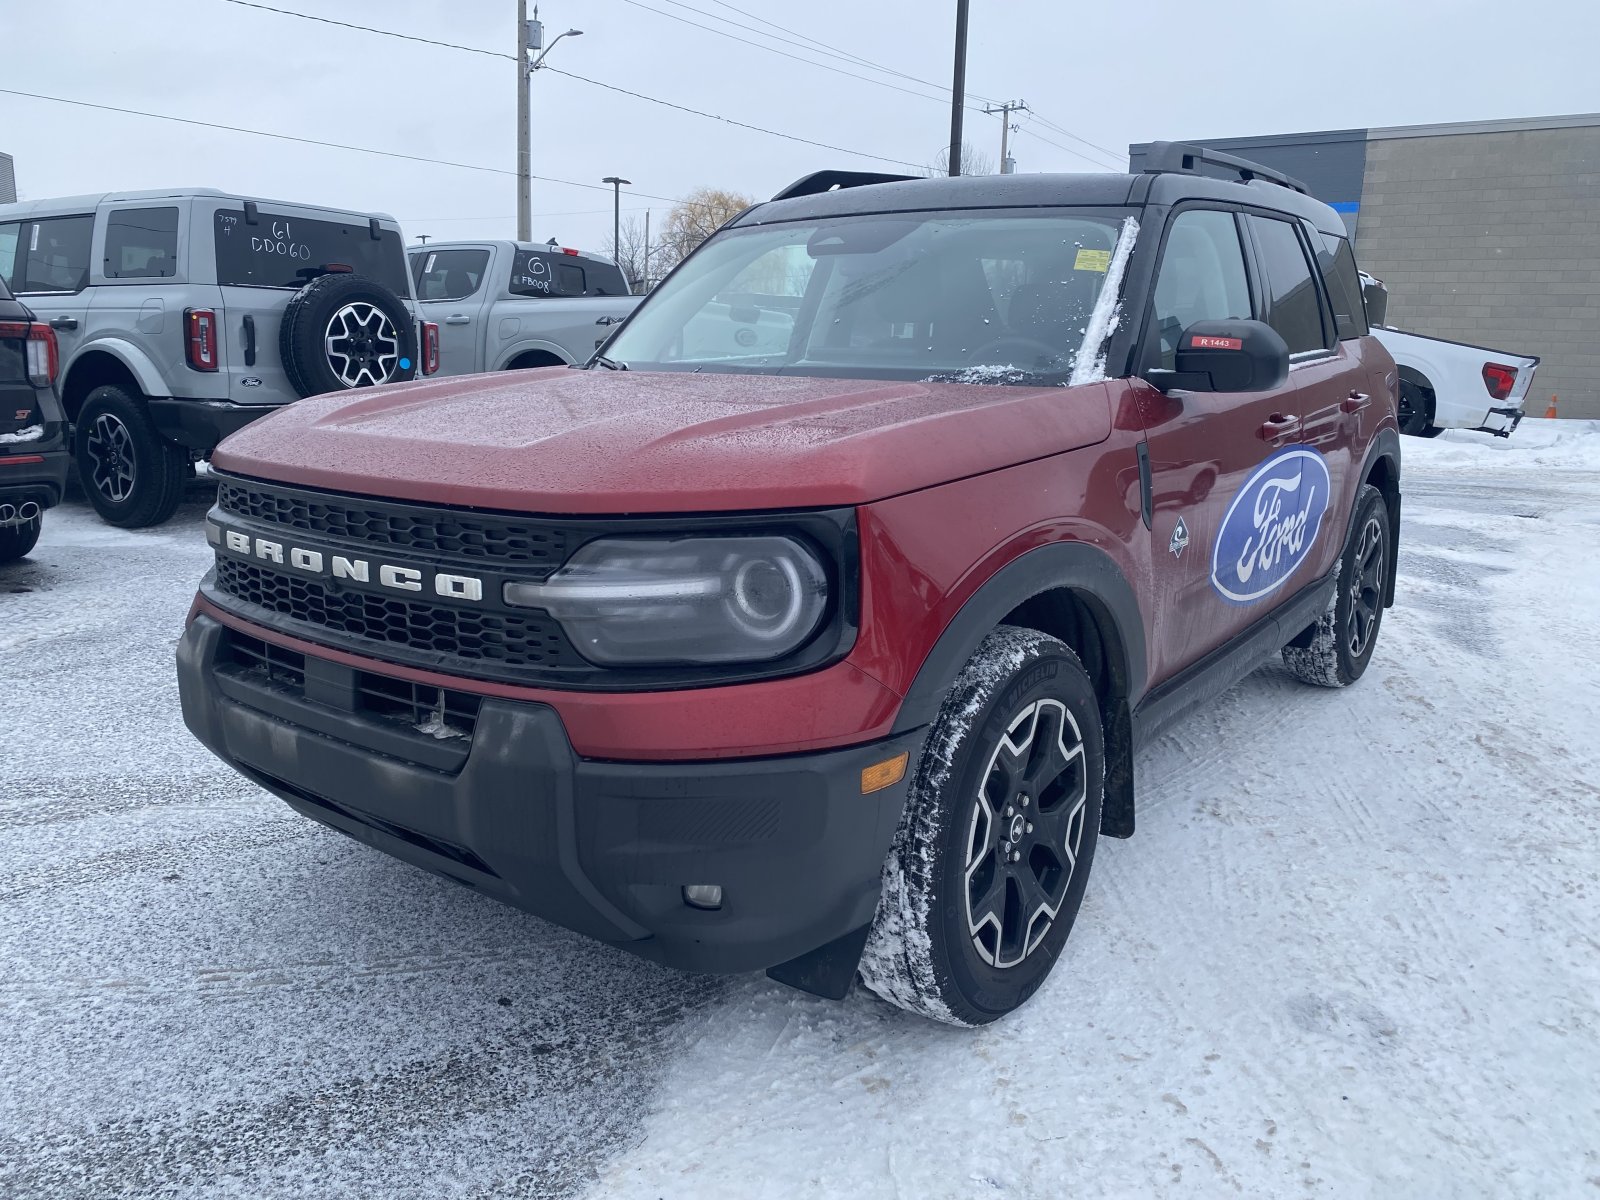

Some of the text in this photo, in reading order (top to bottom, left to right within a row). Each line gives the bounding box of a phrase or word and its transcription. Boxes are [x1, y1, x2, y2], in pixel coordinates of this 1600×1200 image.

[272, 221, 291, 240] 61
[1200, 338, 1230, 347] R 1443
[14, 409, 32, 420] ST
[1236, 472, 1316, 583] Ford
[226, 530, 483, 602] BRONCO
[1008, 664, 1057, 710] MICHELIN
